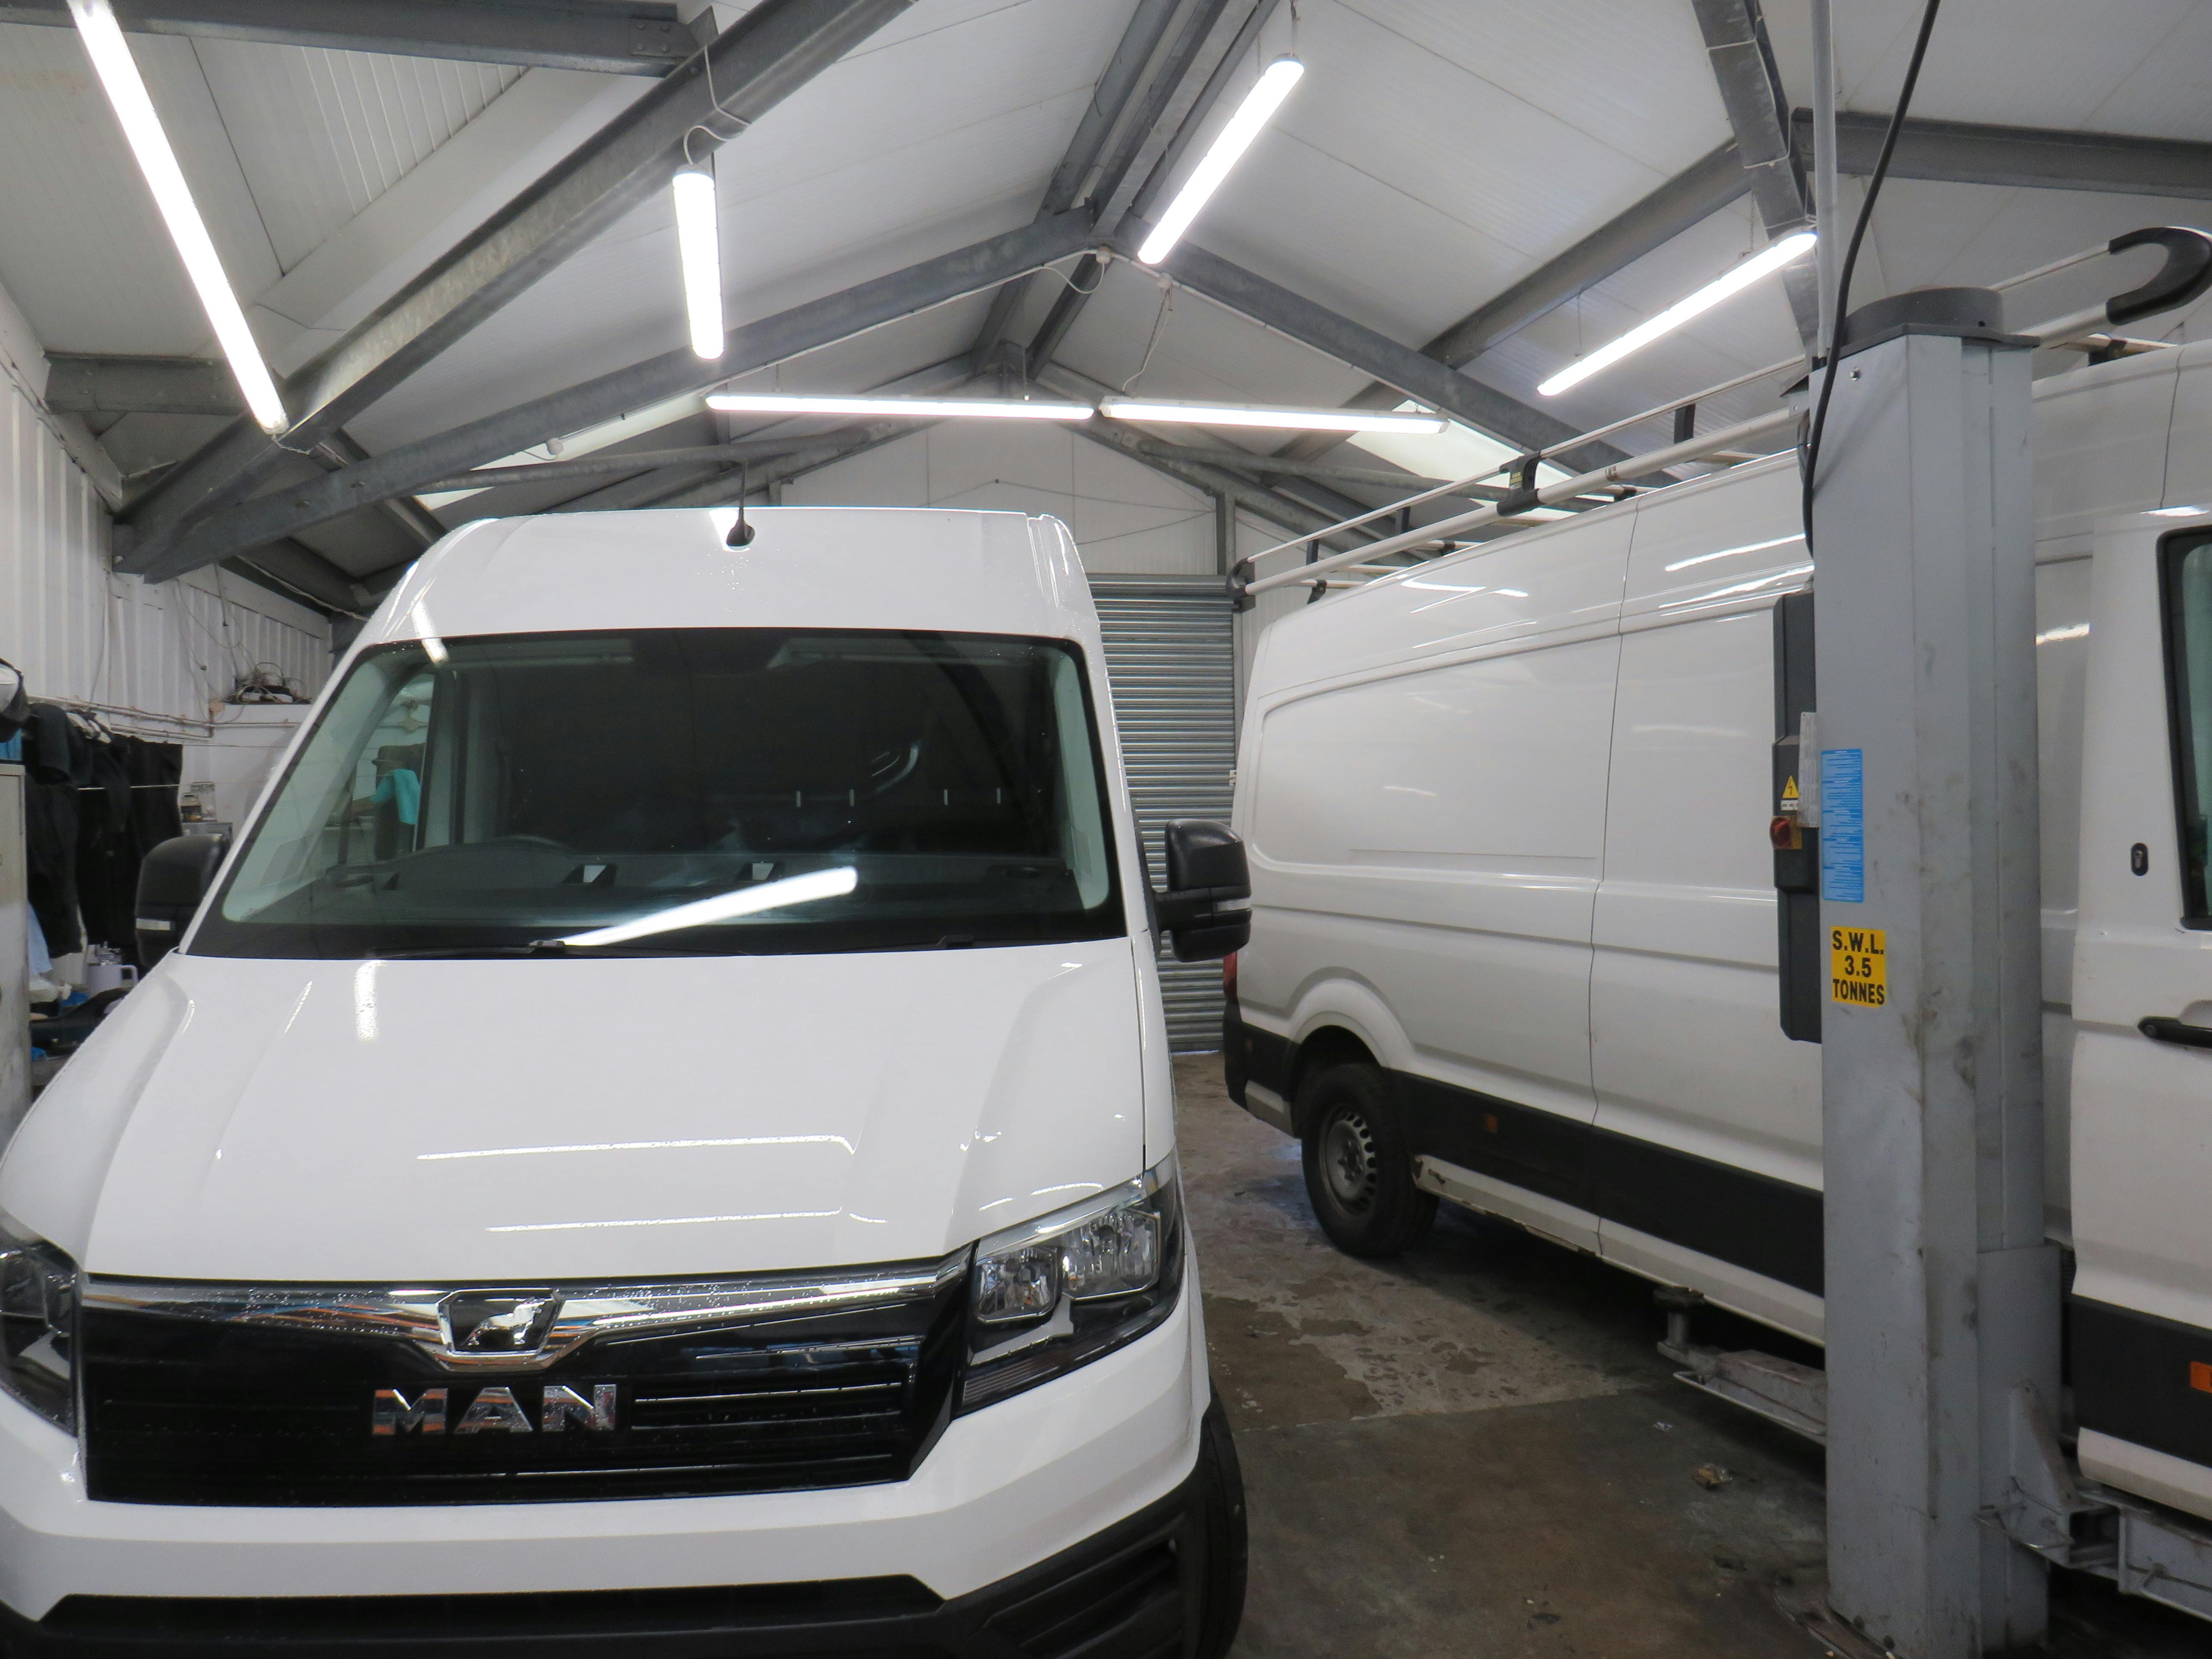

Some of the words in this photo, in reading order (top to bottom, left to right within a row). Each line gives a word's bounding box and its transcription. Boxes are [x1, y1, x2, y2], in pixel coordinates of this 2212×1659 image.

[1832, 930, 1884, 955] S.W.L.
[1845, 955, 1872, 978] 3.5
[1833, 978, 1885, 1005] TONNES
[372, 1384, 617, 1435] MAN
